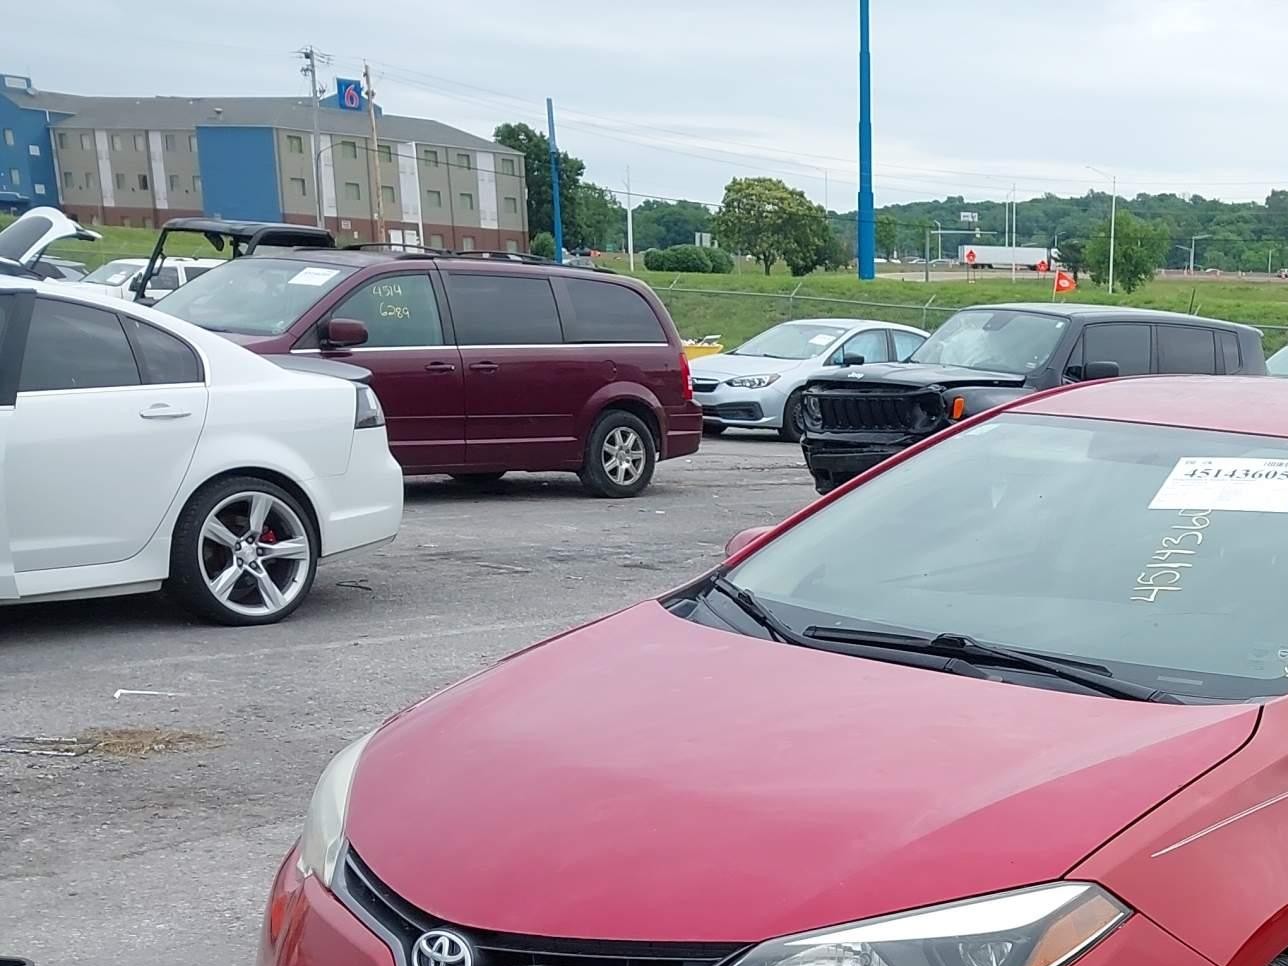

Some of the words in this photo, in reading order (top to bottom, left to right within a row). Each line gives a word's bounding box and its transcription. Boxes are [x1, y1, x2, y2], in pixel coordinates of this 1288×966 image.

[344, 84, 359, 109] 6
[372, 283, 403, 297] 4514
[379, 302, 411, 319] 6289
